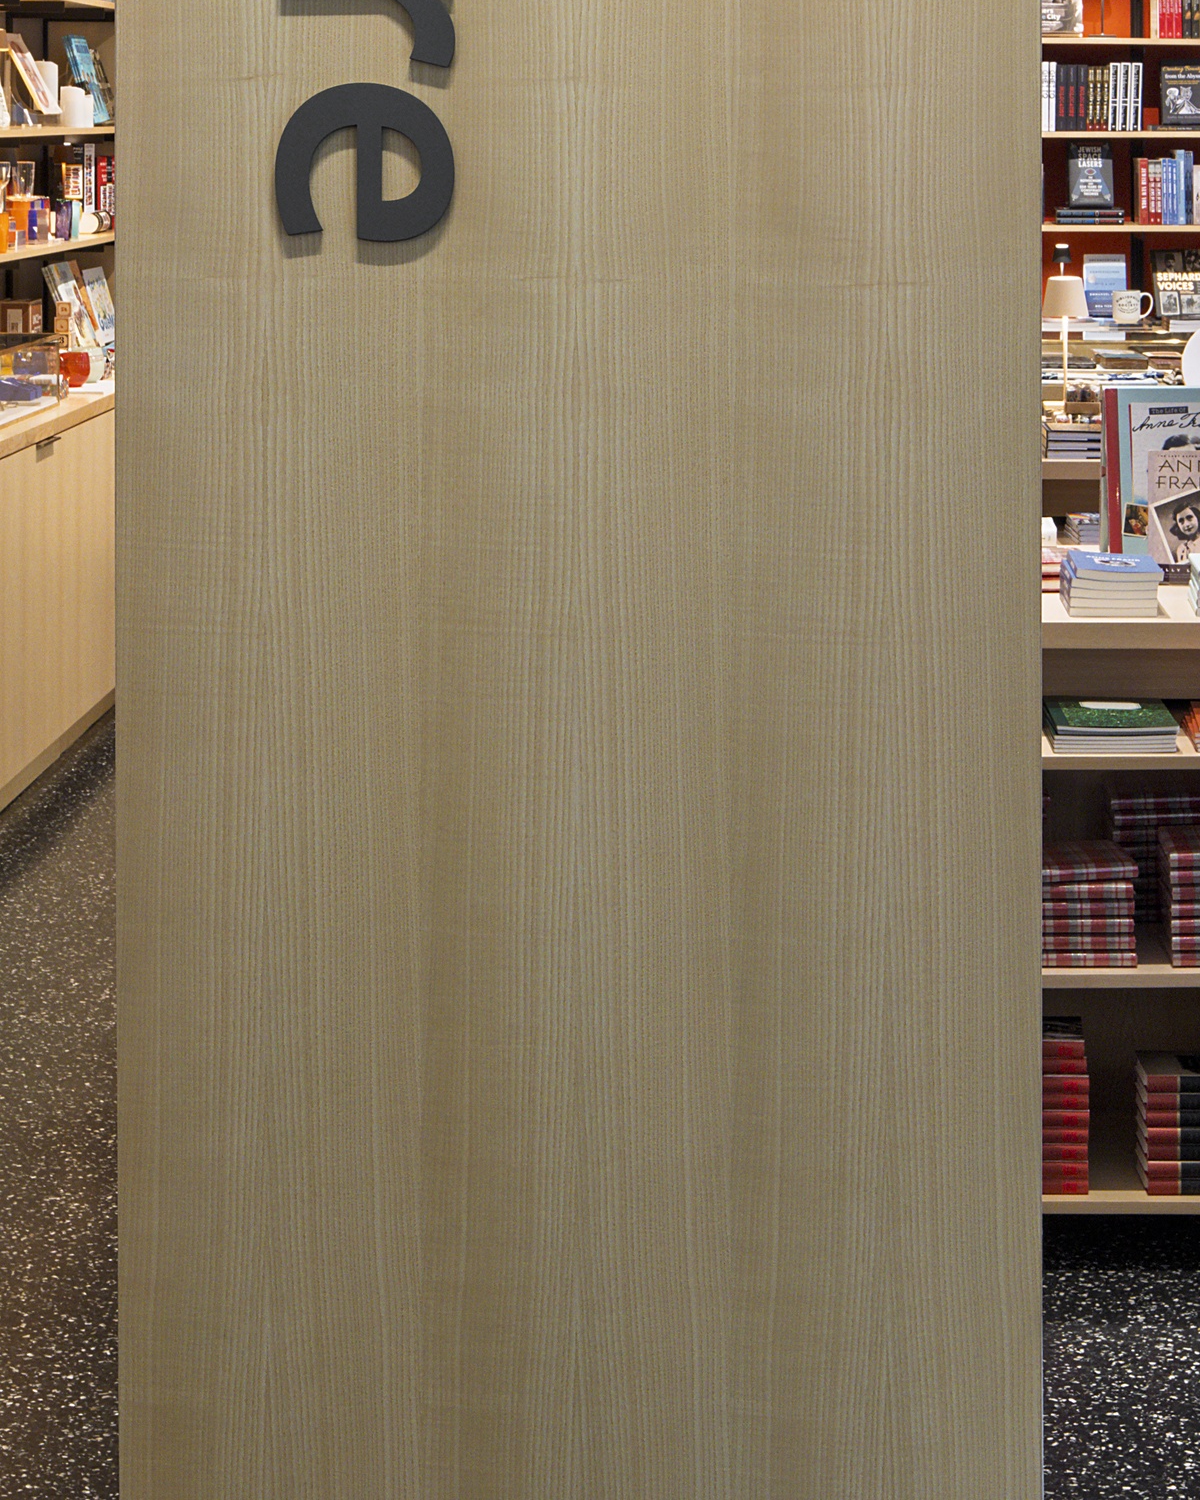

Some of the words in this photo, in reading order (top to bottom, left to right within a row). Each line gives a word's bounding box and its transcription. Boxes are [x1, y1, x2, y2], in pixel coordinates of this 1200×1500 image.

[1047, 13, 1061, 21] City
[1157, 282, 1195, 291] VOICES
[1132, 415, 1178, 433] Anne
